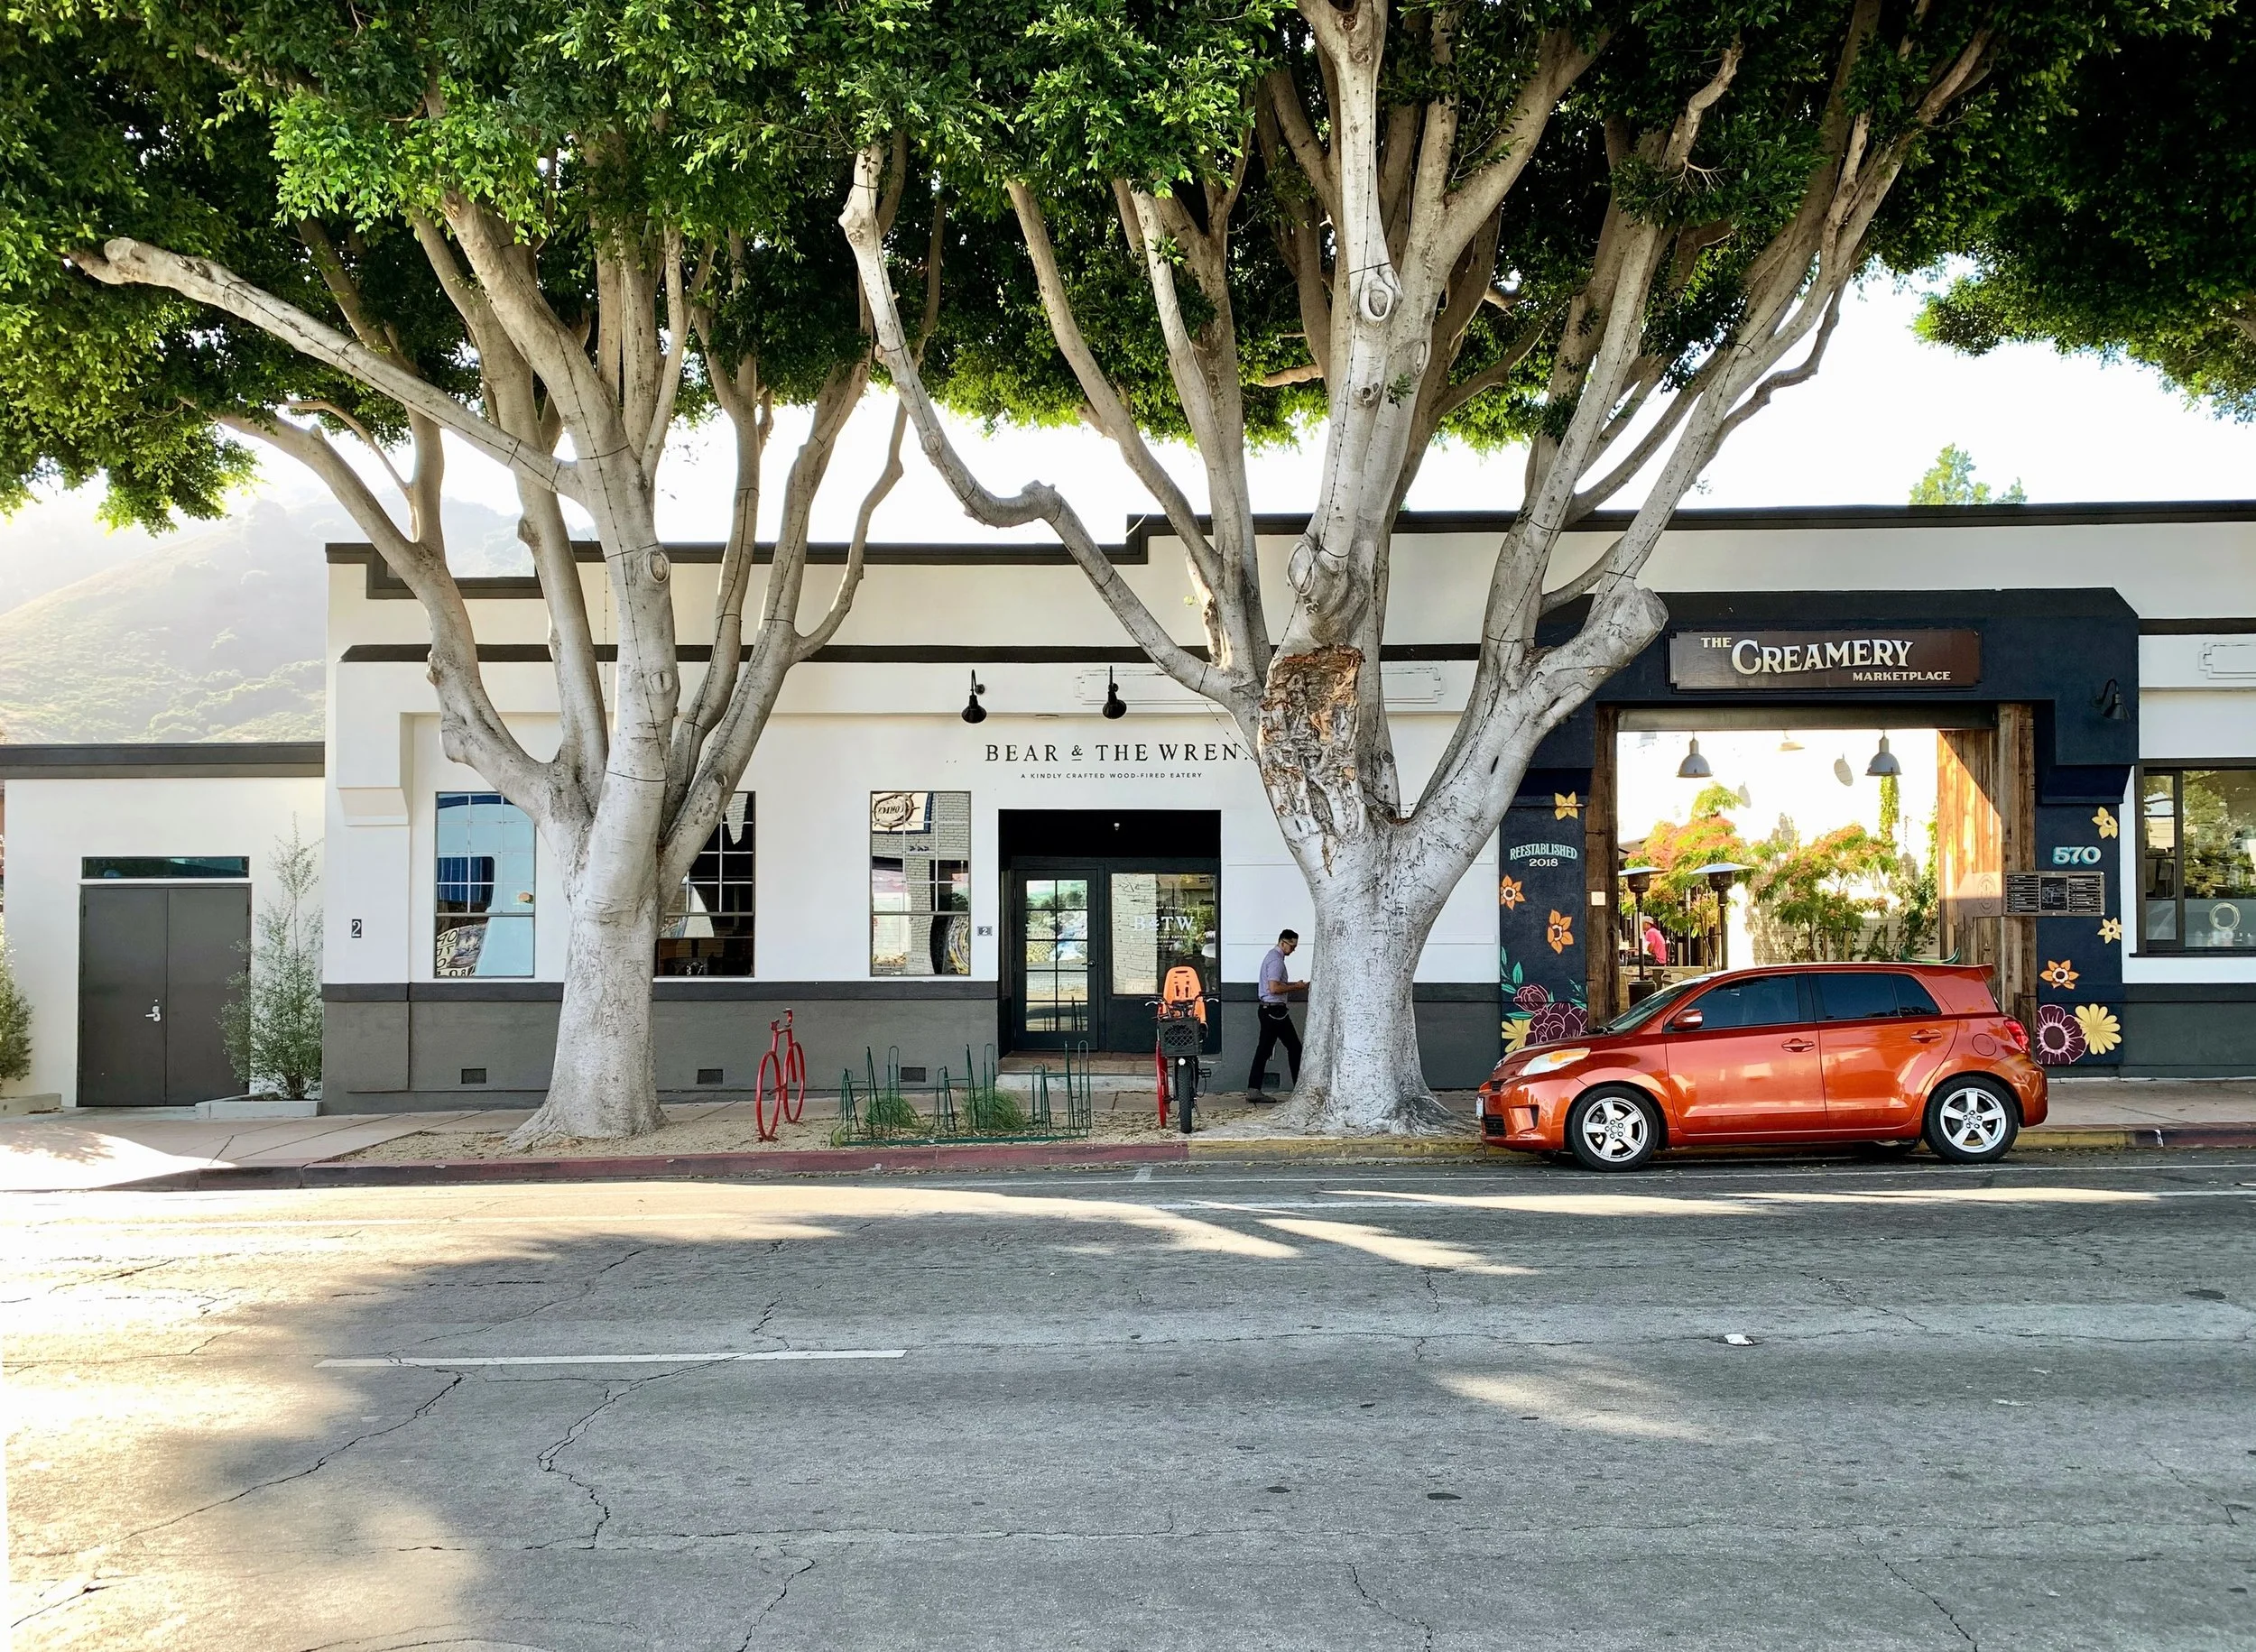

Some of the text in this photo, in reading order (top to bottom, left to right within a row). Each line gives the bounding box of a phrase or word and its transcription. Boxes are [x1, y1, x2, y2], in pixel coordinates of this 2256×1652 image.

[1700, 637, 1732, 648] THE
[1731, 639, 1914, 675] CREAMERY
[1853, 671, 1951, 681] MARKETPLACE
[985, 743, 1059, 761] BEAR
[1071, 744, 1084, 761] &
[1095, 743, 1149, 761] THE
[1510, 843, 1577, 861] REESTABLISHED
[2052, 846, 2102, 865] 570
[1529, 858, 1558, 867] 2018
[352, 920, 361, 937] 2
